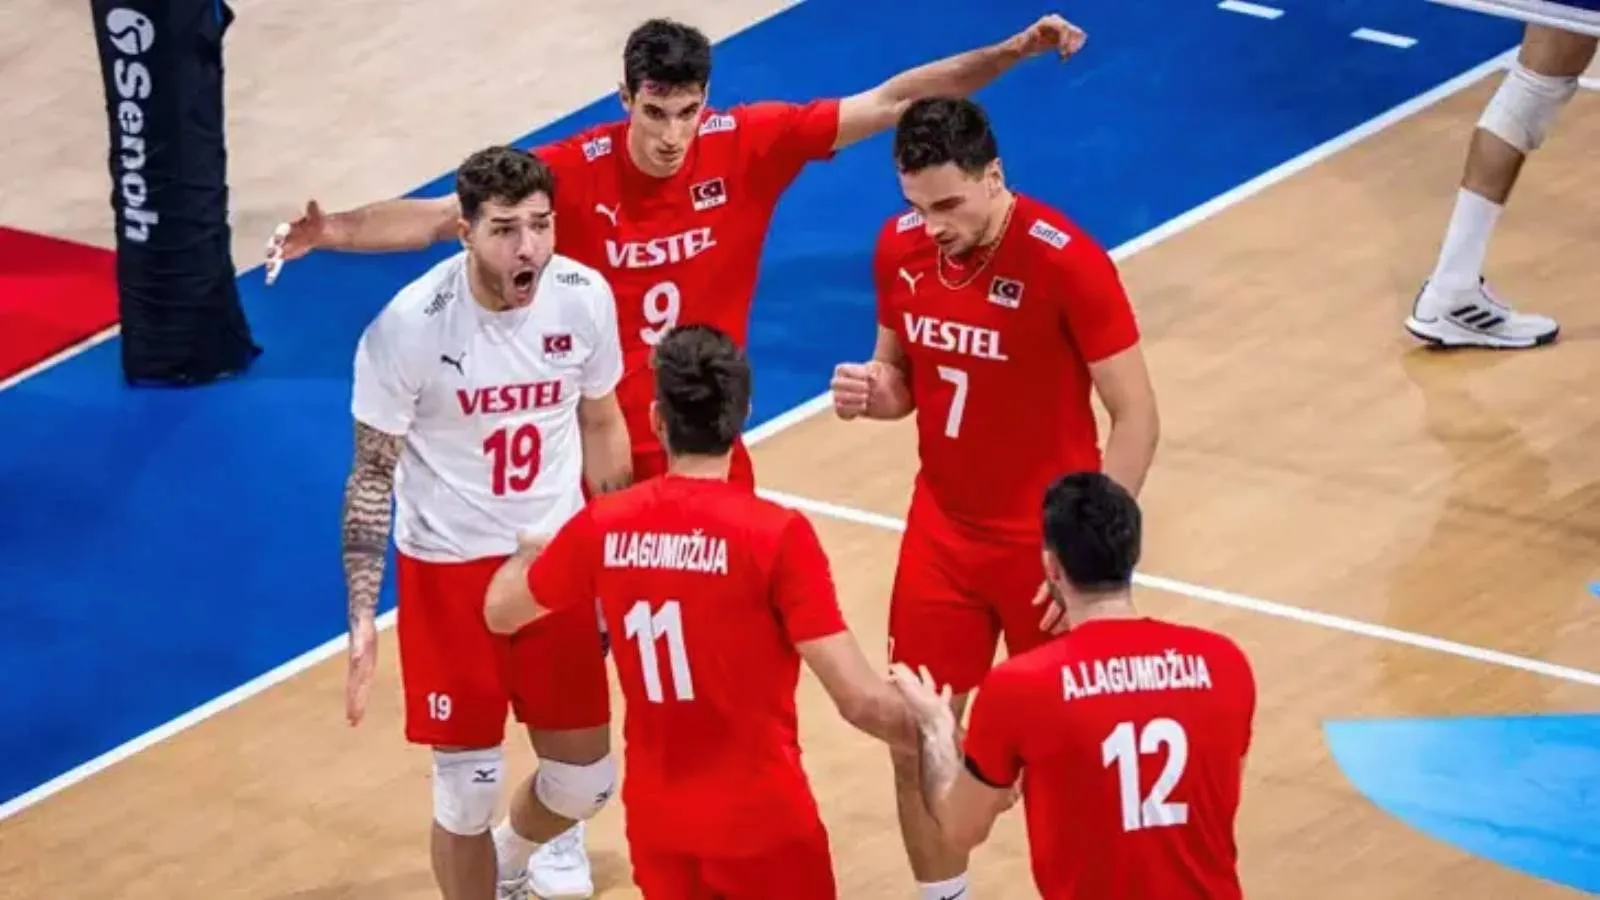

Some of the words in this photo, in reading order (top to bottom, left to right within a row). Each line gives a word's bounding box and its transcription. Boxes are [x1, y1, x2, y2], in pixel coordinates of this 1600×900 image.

[114, 58, 159, 242] Senoh
[605, 227, 717, 268] VESTEL
[640, 281, 680, 346] 9
[903, 312, 1009, 361] VESTEL
[457, 379, 562, 415] VESTEL
[936, 365, 969, 439] 7
[483, 423, 542, 496] 19
[624, 600, 695, 704] 11
[1061, 648, 1213, 701] A.LAGUMDŽIJA
[427, 691, 452, 721] 19
[1100, 716, 1189, 832] 12
